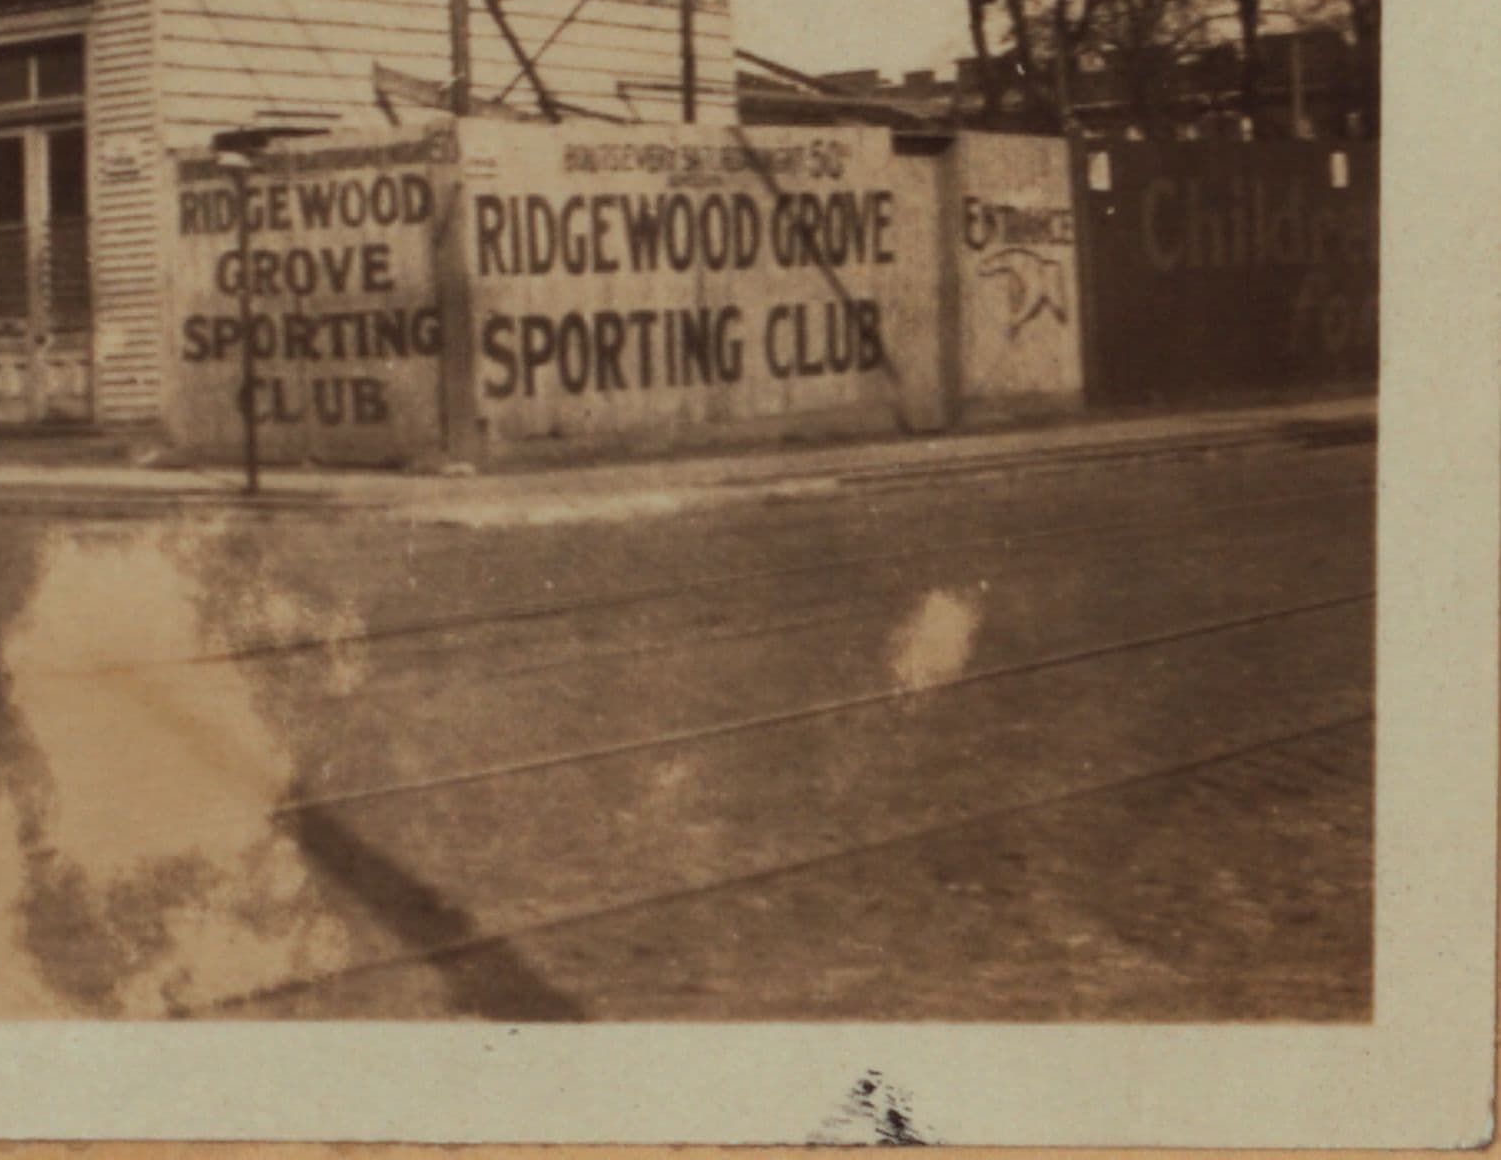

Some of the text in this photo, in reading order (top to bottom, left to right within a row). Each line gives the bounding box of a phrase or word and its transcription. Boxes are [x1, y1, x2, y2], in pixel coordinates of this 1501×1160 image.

[179, 174, 435, 236] RIDGEWOOD
[474, 190, 895, 277] RIDGEWOOD GROVE
[215, 244, 395, 298] GROVE
[182, 305, 445, 362] SPORTING
[482, 299, 885, 400] SPORTING CLUB
[238, 376, 391, 425] CLUB
